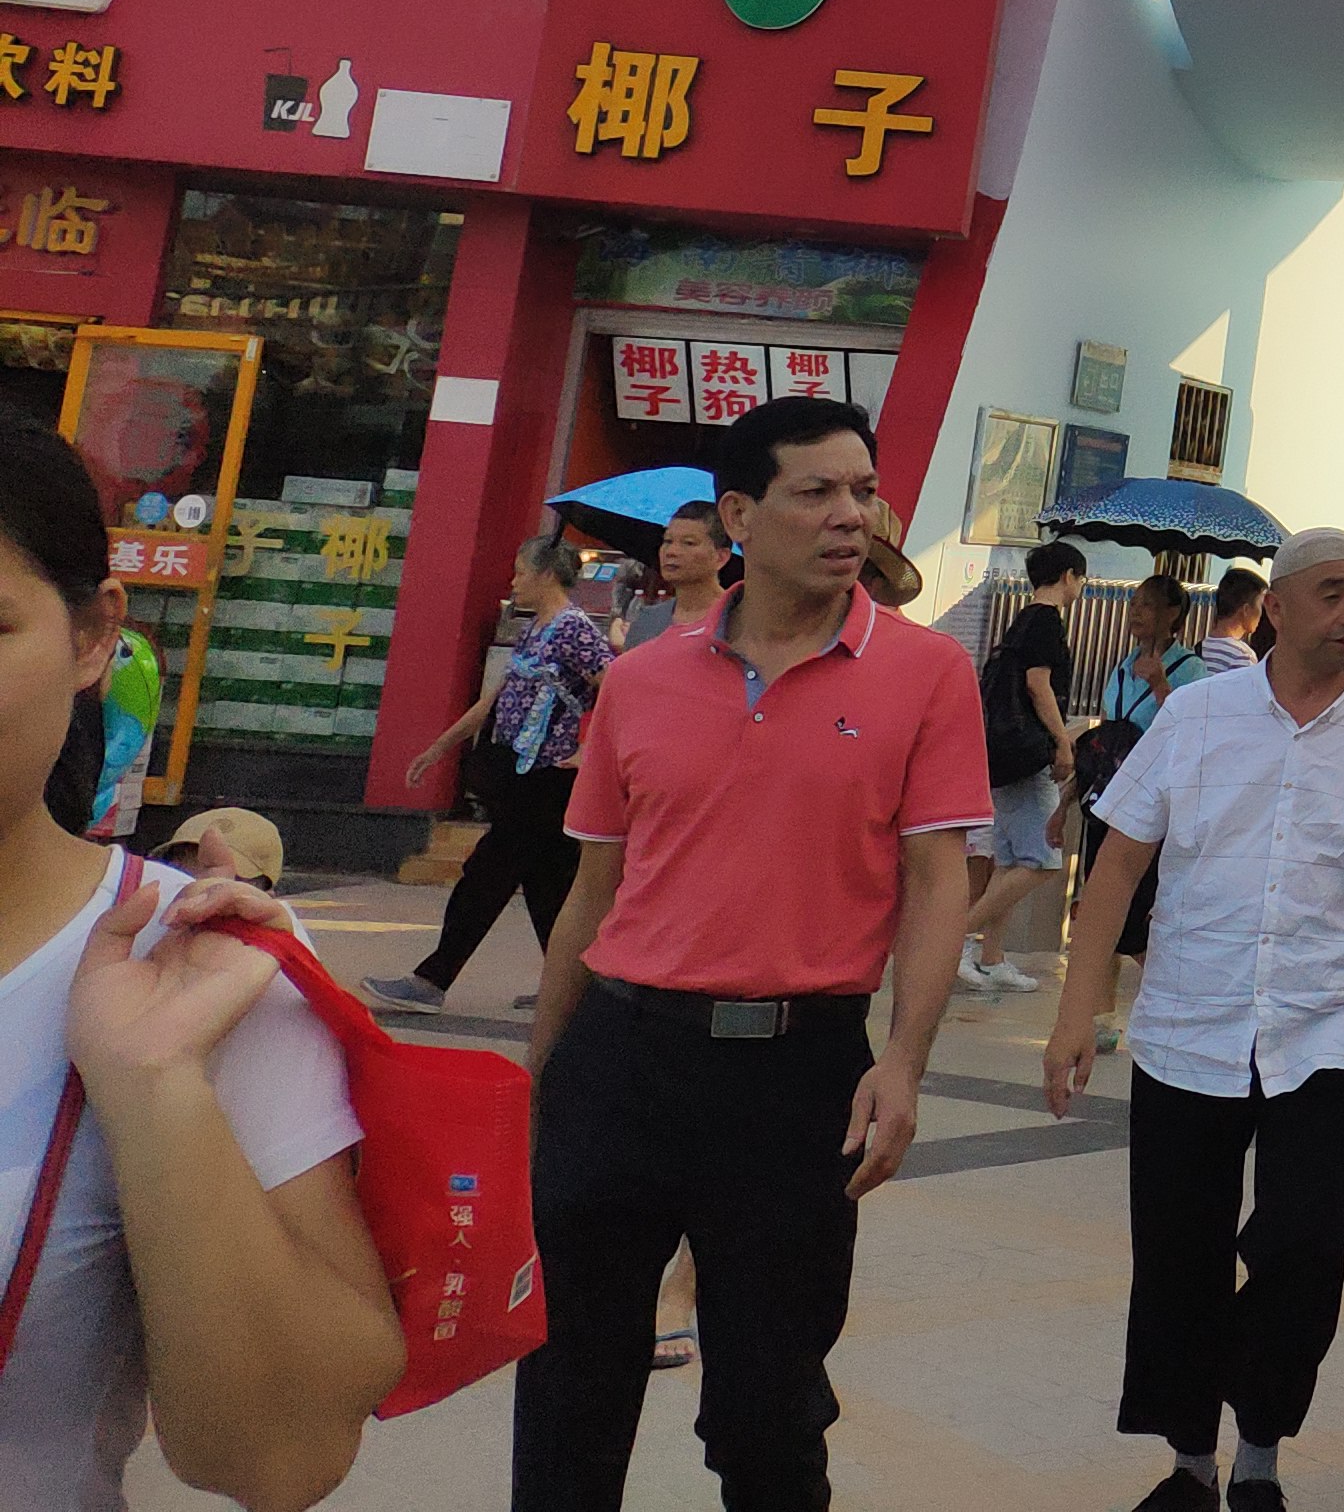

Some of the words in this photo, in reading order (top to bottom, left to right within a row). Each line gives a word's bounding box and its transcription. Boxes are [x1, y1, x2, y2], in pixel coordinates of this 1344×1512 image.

[271, 99, 316, 122] KJL
[567, 42, 934, 177] 椰子
[0, 187, 110, 254] 临
[620, 343, 681, 416] 椰子
[701, 349, 758, 421] 热狗
